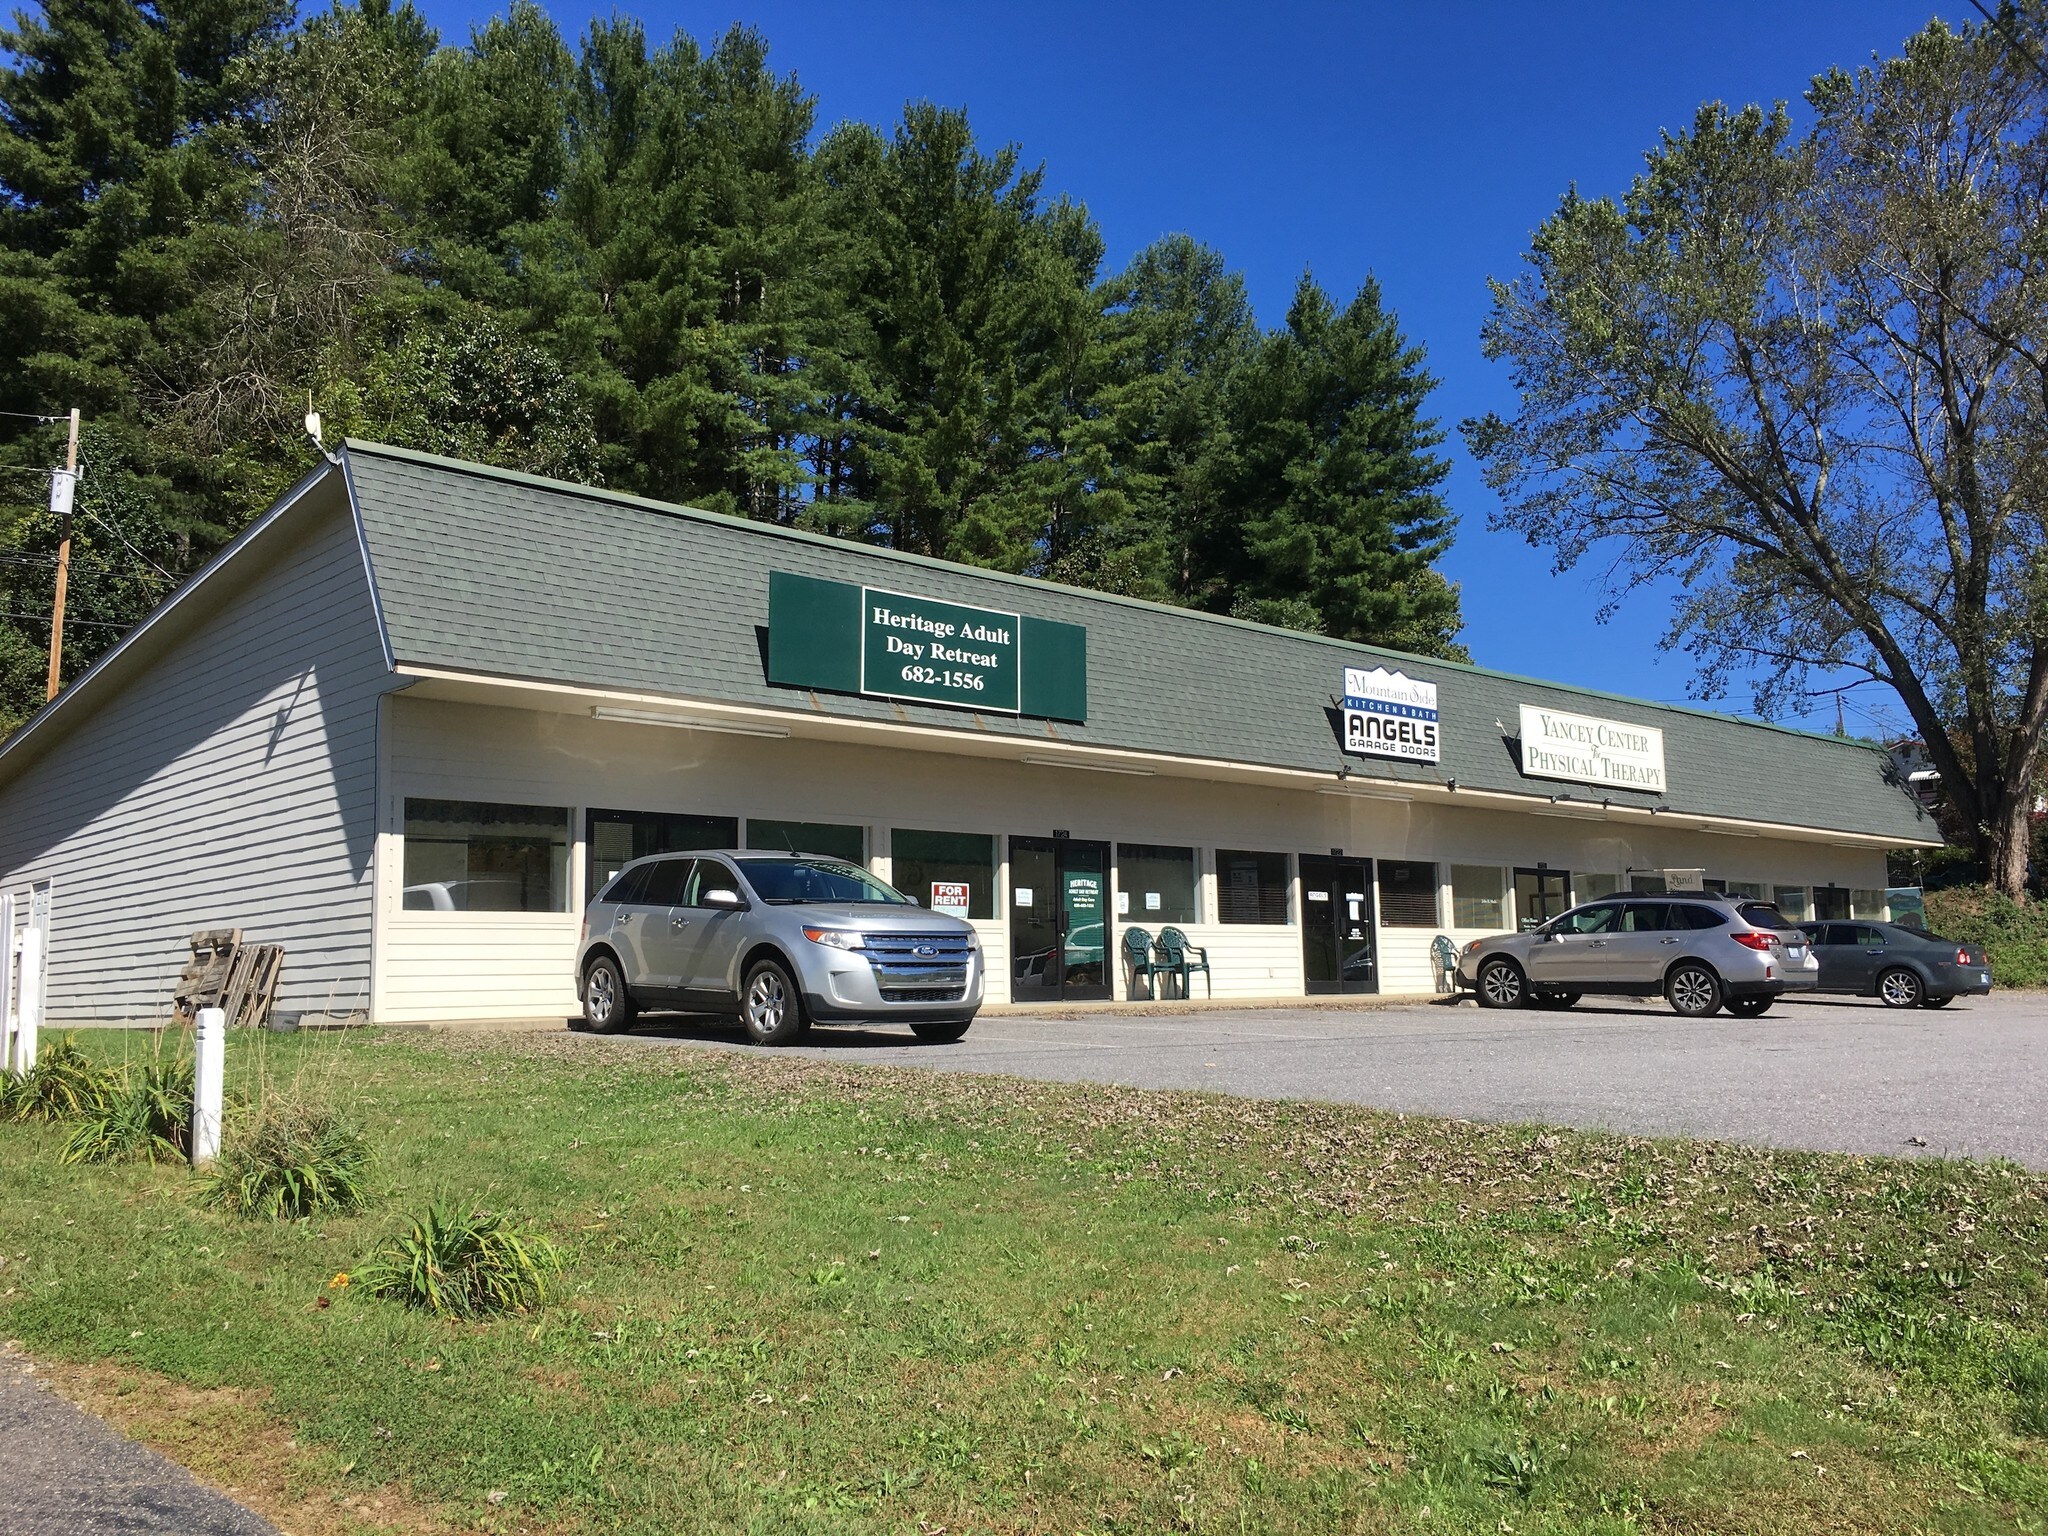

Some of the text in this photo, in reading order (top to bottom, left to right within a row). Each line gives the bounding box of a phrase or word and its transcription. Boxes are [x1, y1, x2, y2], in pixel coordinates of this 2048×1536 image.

[873, 607, 1010, 645] Heritage Adult
[886, 636, 998, 668] Day Retreat
[901, 665, 984, 690] 682-1556
[1348, 674, 1435, 706] Mountain Side
[1347, 698, 1436, 720] KITCHEN & BATH
[1349, 714, 1436, 746] ANGELS
[1540, 714, 1649, 753] YANCEY CENTER
[1349, 738, 1436, 757] GARAGE DOORS
[1528, 746, 1661, 785] PHYSICAL THERAPY
[938, 885, 963, 896] FOR
[1070, 879, 1097, 889] HERITAGE
[934, 895, 966, 905] RENT
